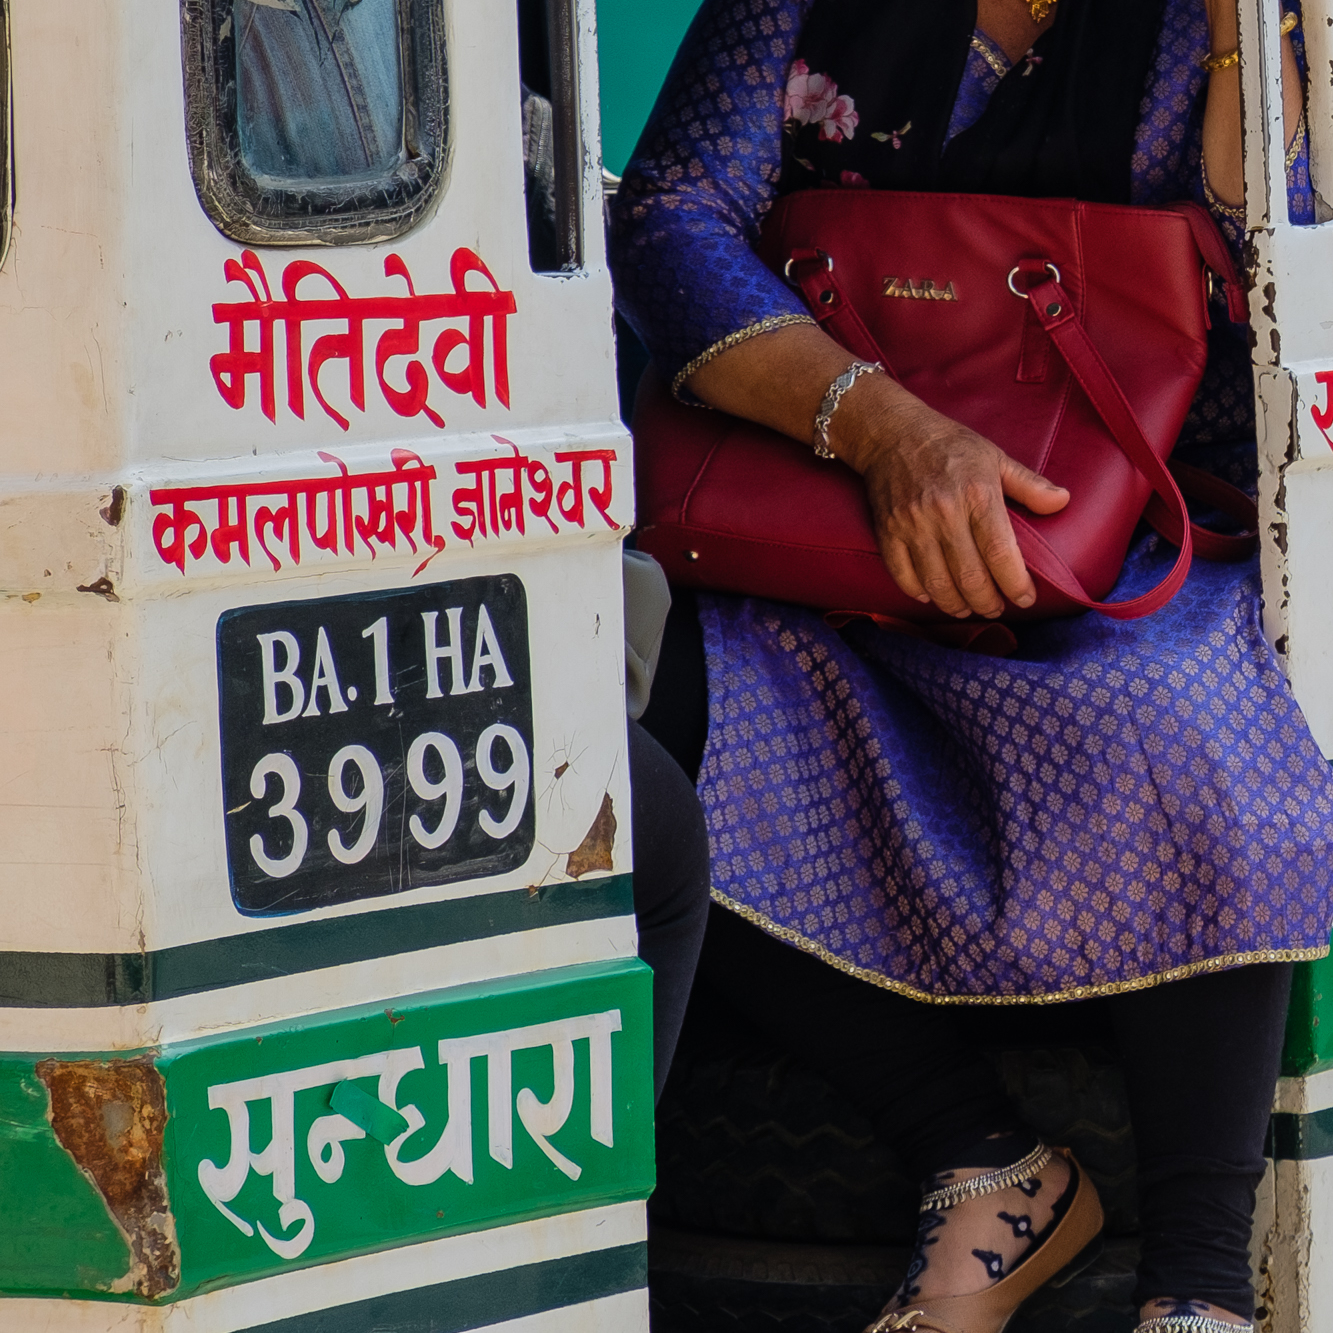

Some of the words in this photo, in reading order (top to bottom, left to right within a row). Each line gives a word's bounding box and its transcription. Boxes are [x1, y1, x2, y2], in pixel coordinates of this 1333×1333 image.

[209, 246, 517, 432] मैतिदेवी
[881, 277, 958, 302] ZARA
[421, 603, 514, 699] HA
[249, 723, 530, 879] 3999
[198, 1009, 623, 1259] सुन्धारा
